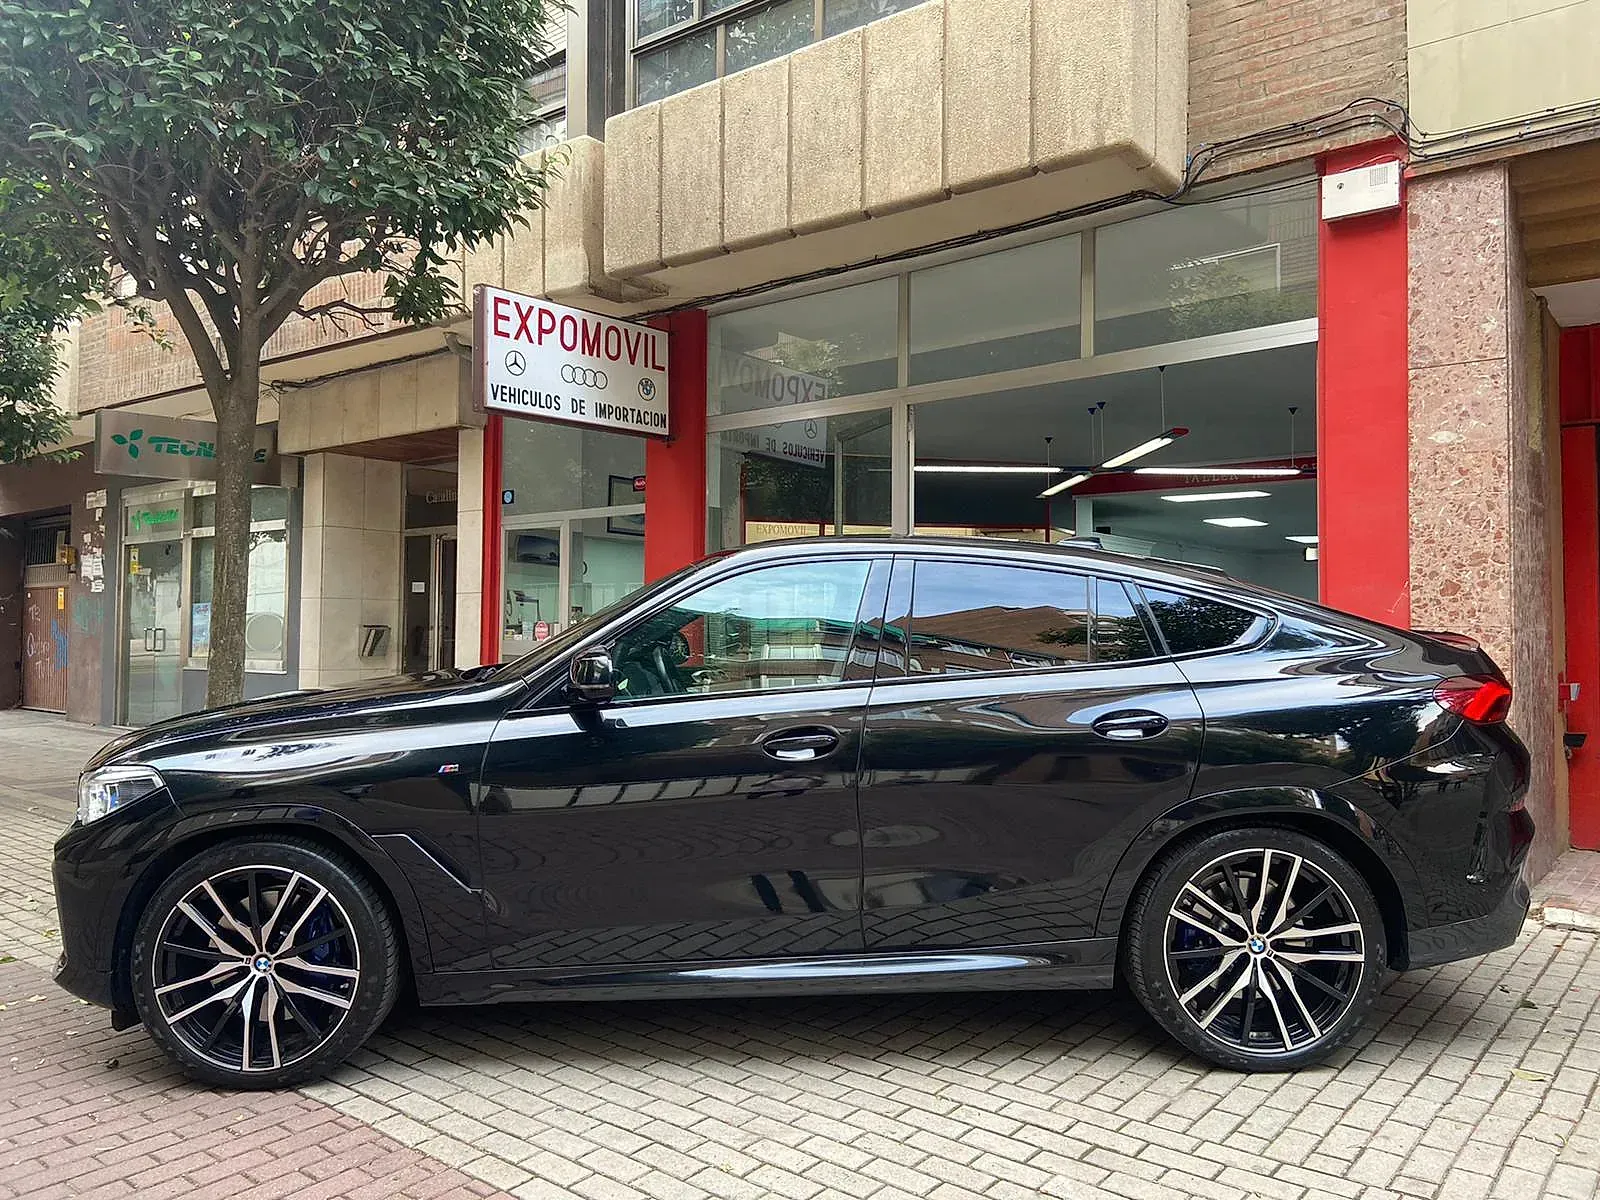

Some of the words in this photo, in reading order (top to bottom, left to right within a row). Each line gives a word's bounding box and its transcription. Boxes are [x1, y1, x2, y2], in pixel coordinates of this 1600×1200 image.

[493, 296, 666, 372] EXPOMOVIL
[490, 383, 561, 411] VEHICULOS
[571, 398, 586, 416] DE
[595, 402, 667, 428] IMPORTACION
[756, 524, 808, 536] EXPOMOVIL
